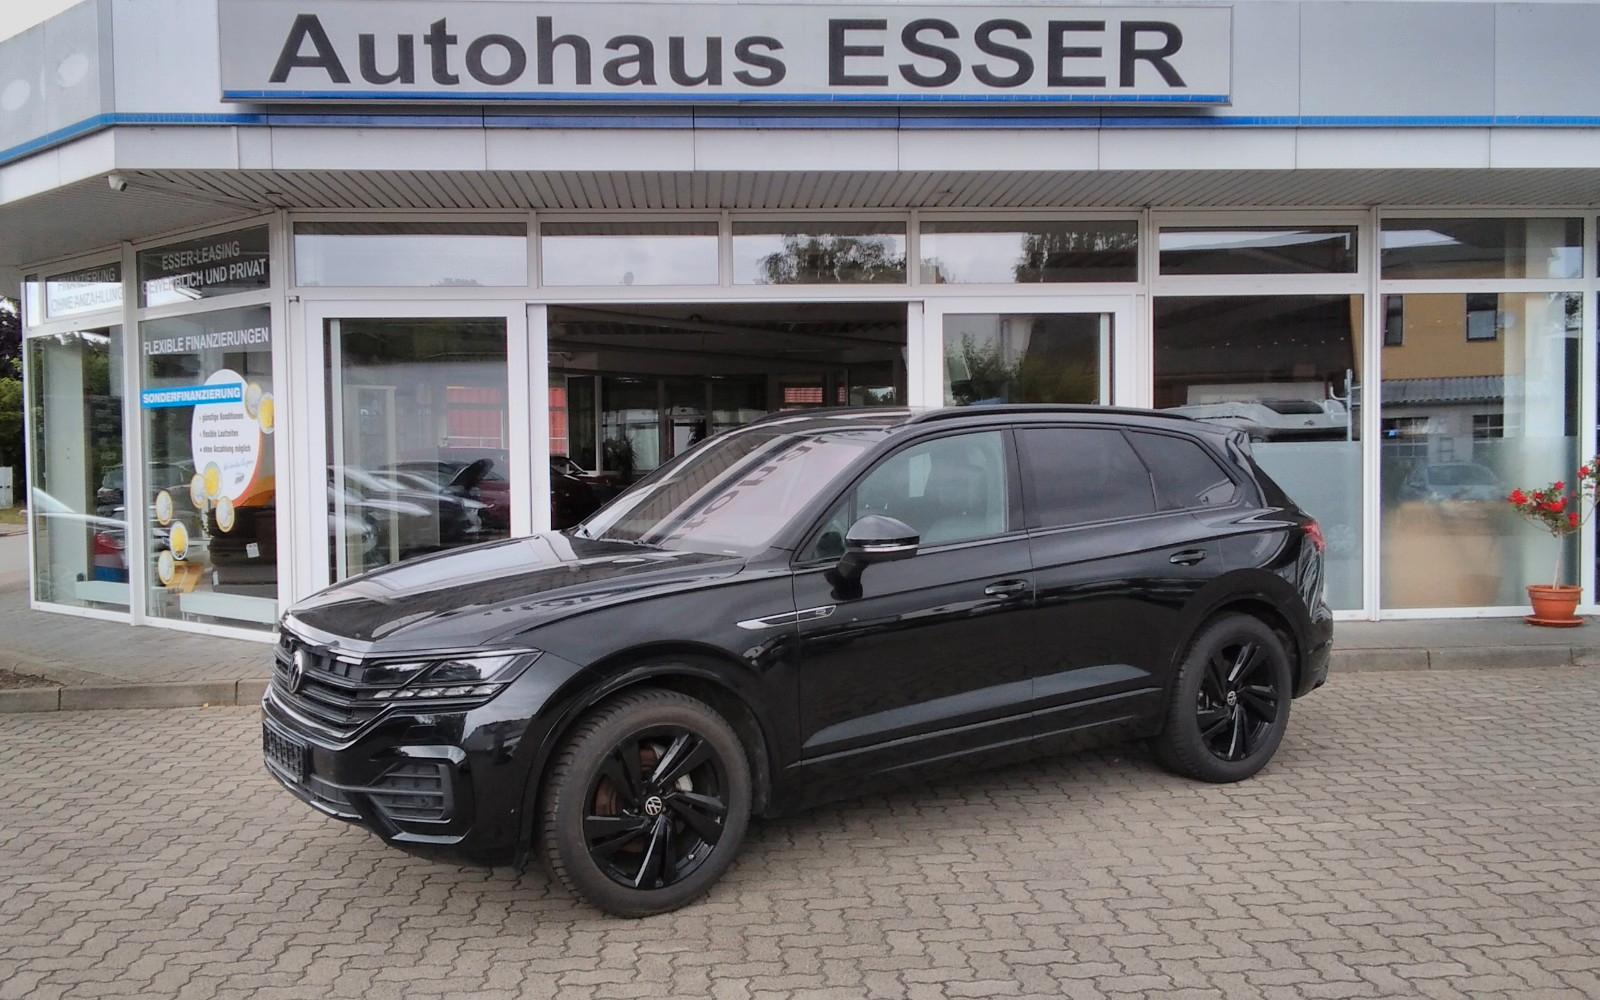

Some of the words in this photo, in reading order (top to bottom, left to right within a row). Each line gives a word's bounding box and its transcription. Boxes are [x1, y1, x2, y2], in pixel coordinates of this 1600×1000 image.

[270, 14, 785, 86] Autohaus
[829, 18, 1186, 88] ESSER
[162, 241, 240, 270] ESSER-LEASING
[205, 265, 228, 285] UND
[229, 258, 266, 281] PRIVAT
[143, 338, 184, 356] FLEXIBLE
[185, 327, 269, 350] FINANZIERUNGEN
[143, 387, 241, 404] SONDERFINANZIERUNG
